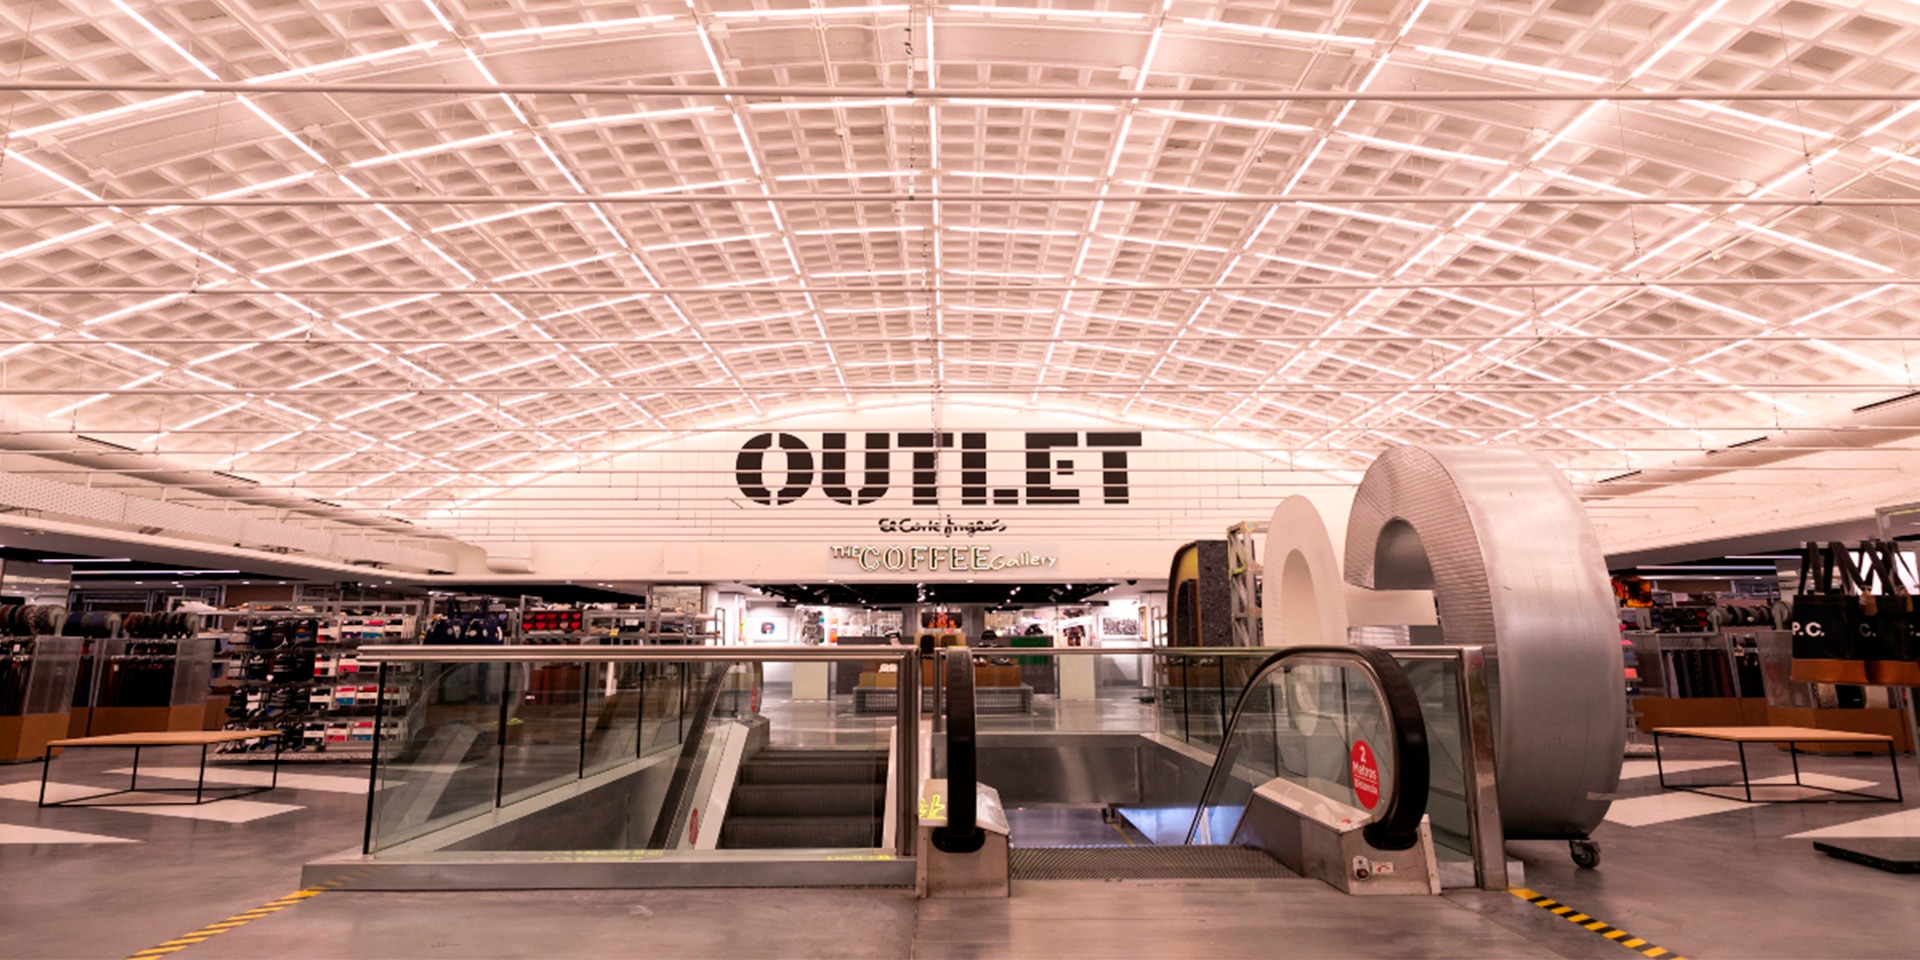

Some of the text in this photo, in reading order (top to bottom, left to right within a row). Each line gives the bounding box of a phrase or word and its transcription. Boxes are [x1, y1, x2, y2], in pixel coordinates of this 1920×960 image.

[735, 432, 1142, 505] OUTLET
[899, 518, 941, 533] Corte
[831, 545, 1057, 571] THE COFFEE Gallery
[1359, 745, 1367, 763] 2
